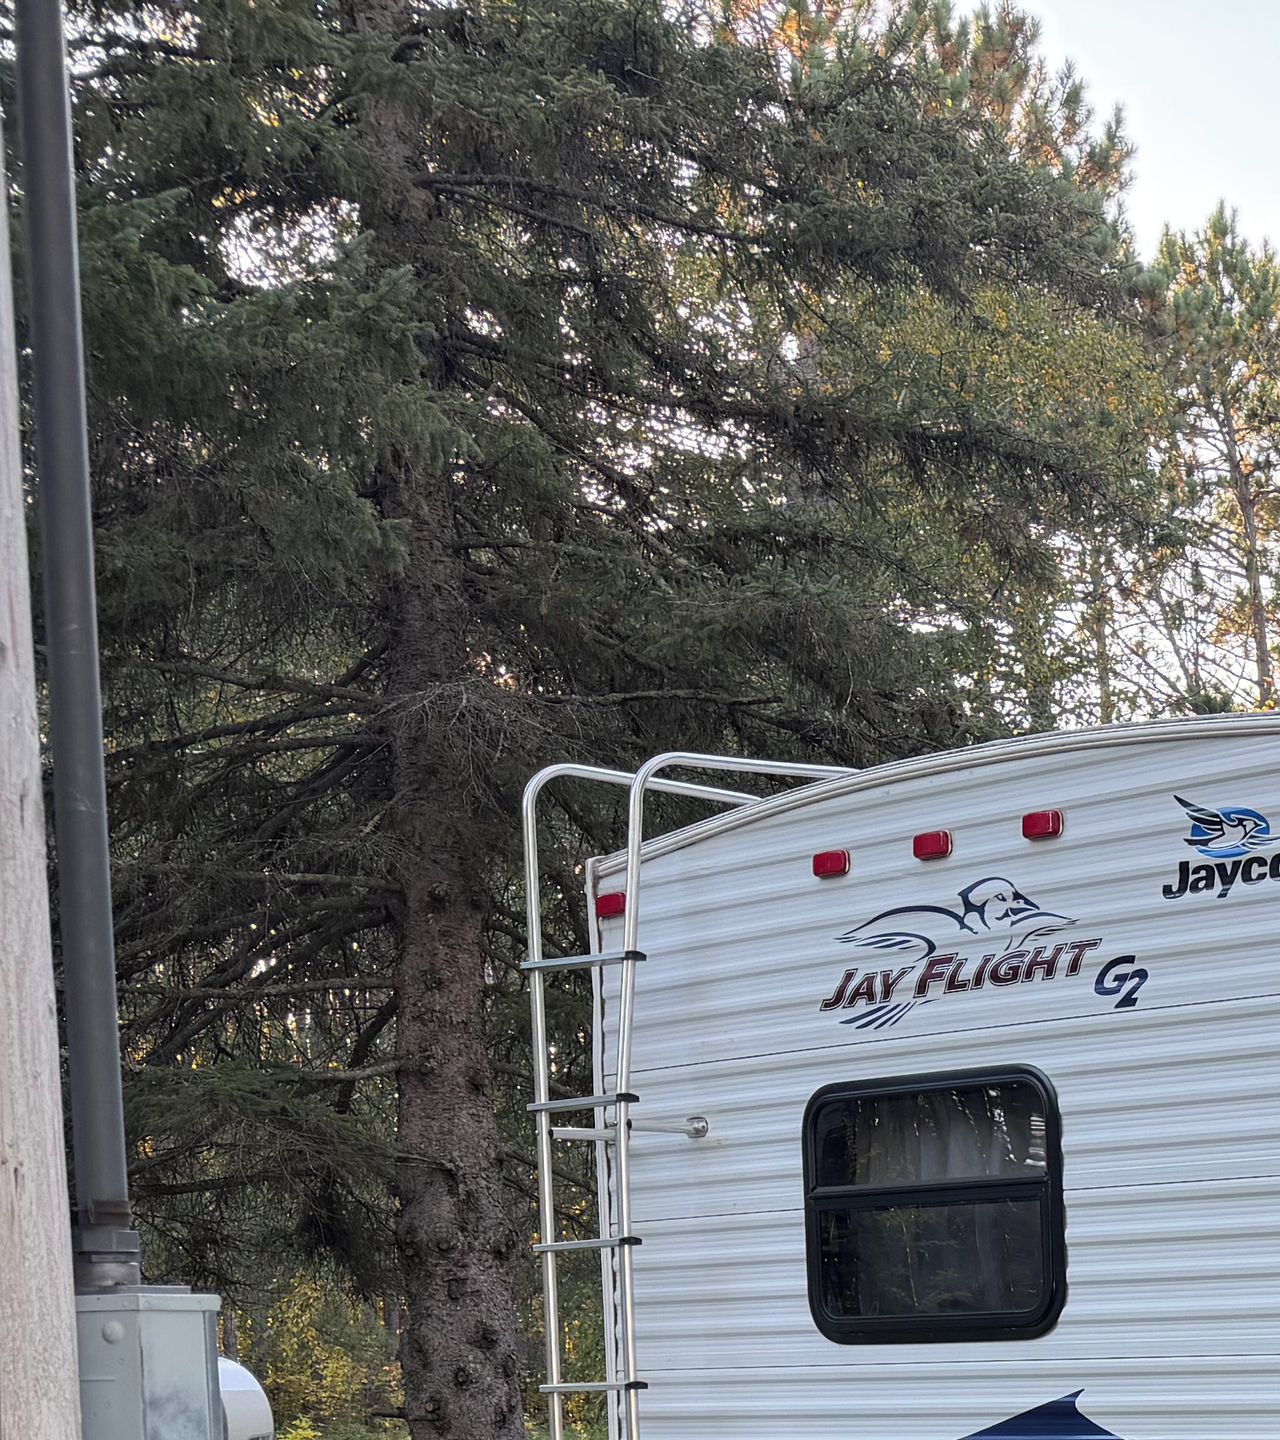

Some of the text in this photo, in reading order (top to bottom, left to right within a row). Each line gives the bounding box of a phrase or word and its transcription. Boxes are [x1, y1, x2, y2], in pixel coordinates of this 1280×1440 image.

[819, 938, 1149, 1012] JAY FLIGHT G2
